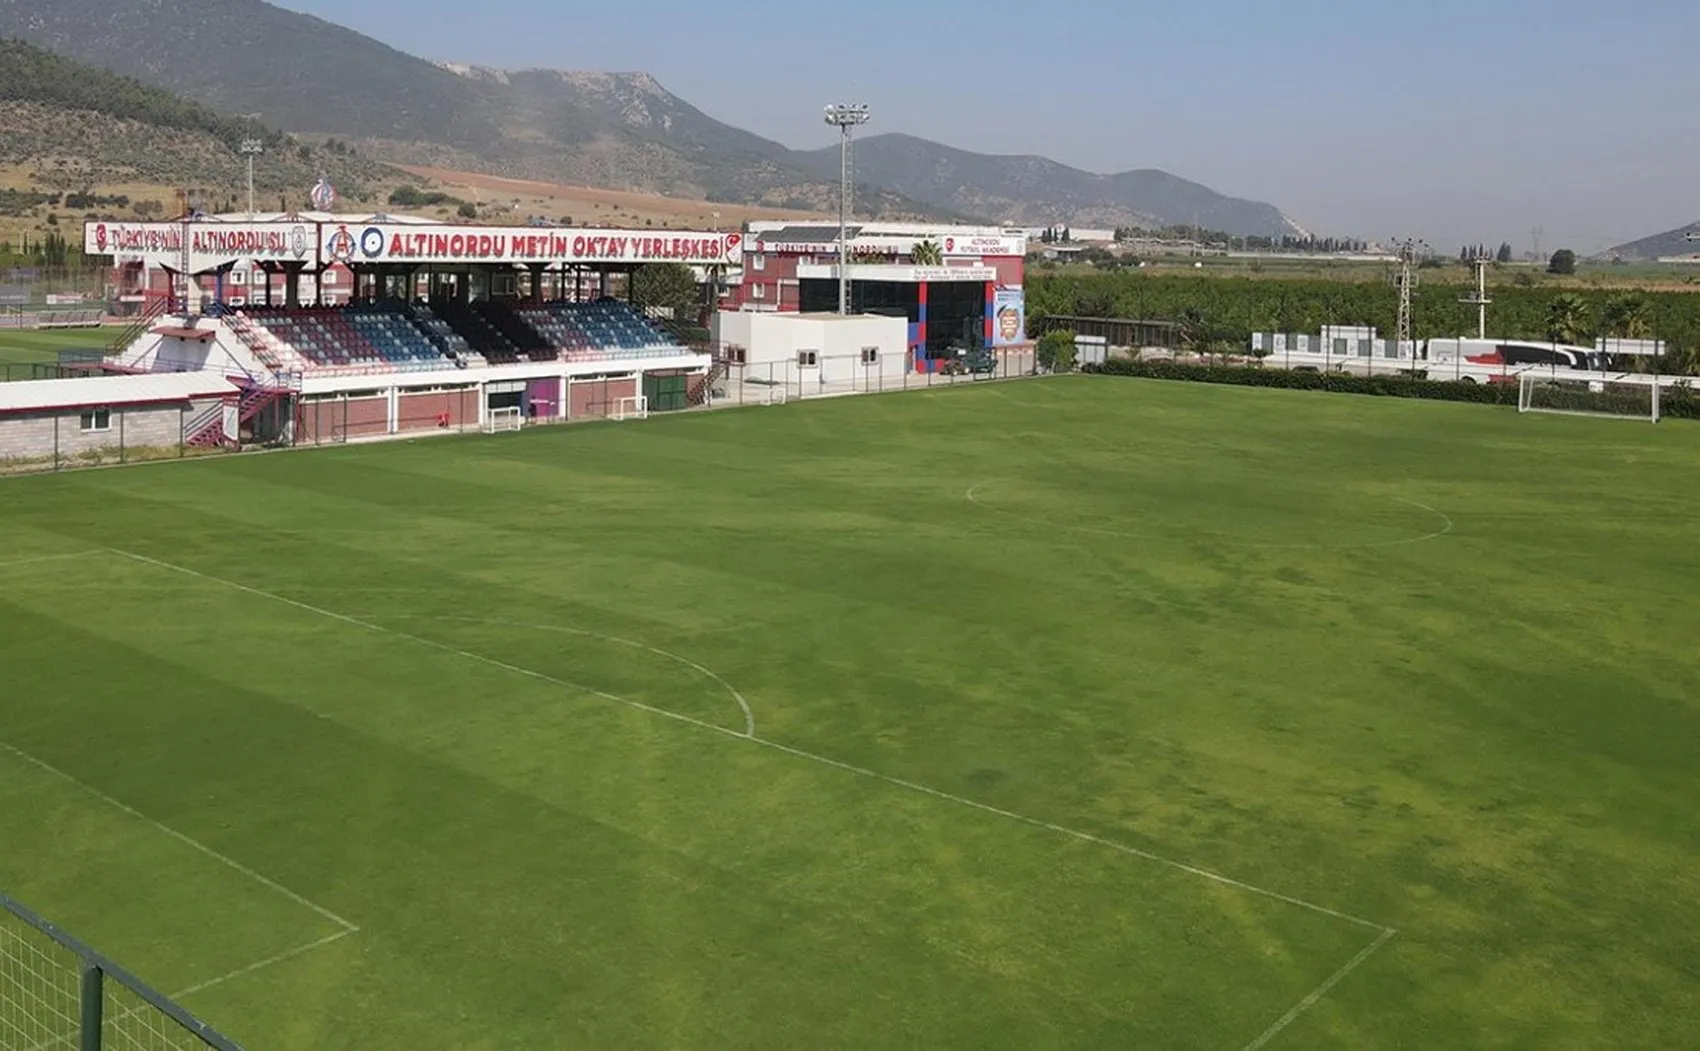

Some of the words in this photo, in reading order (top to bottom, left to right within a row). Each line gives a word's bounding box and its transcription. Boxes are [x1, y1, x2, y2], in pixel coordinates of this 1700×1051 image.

[388, 233, 505, 258] ALTINORDU
[511, 231, 566, 257] METİN
[573, 235, 628, 257] OKTAY
[631, 236, 725, 260] YERLEŞKESİ
